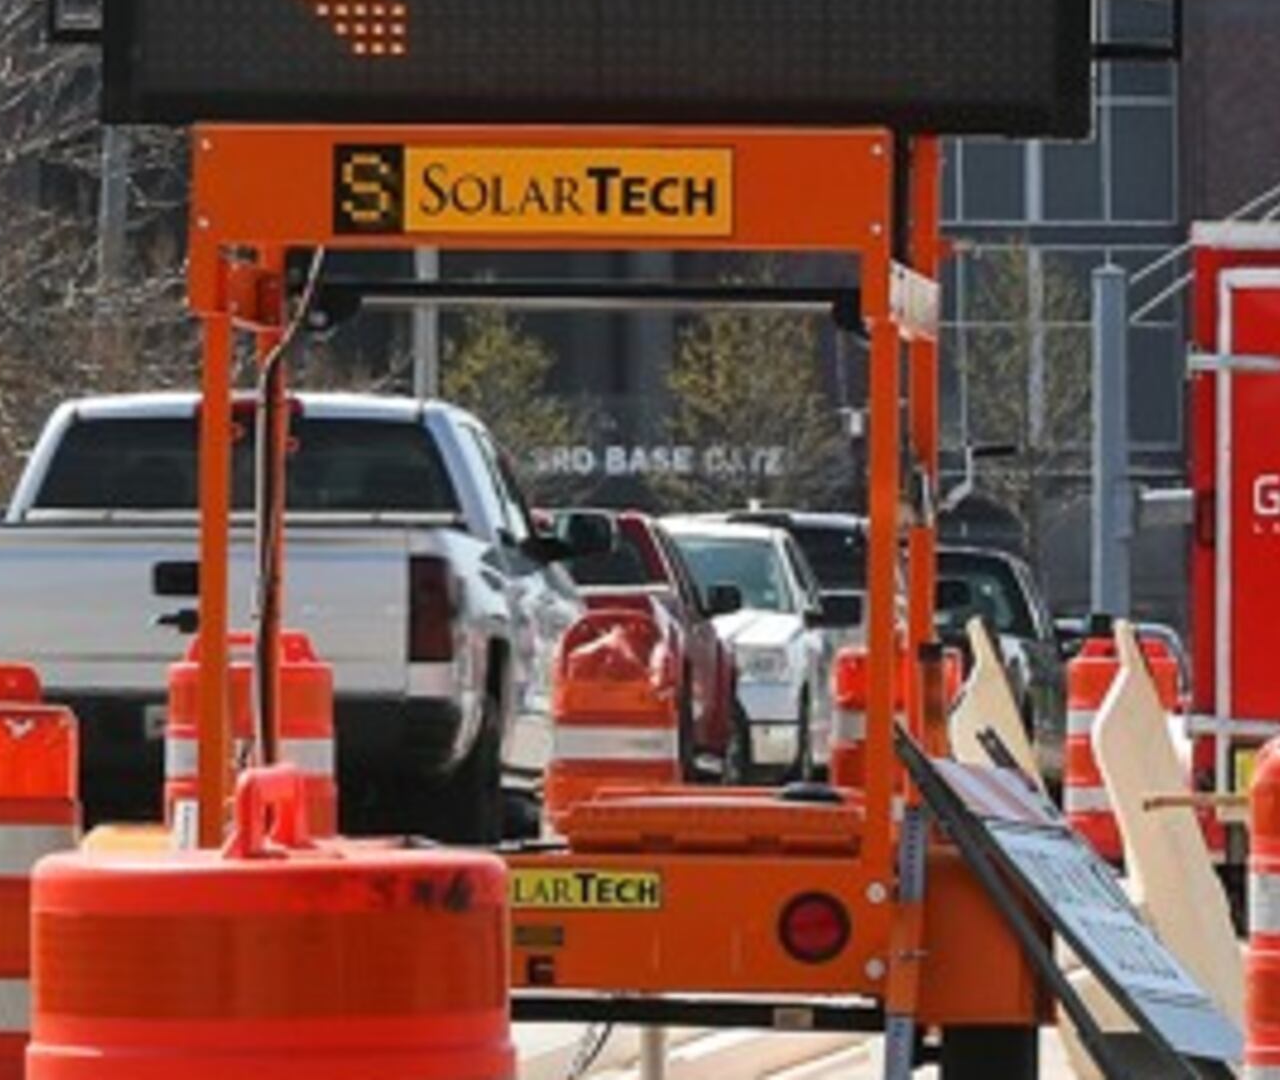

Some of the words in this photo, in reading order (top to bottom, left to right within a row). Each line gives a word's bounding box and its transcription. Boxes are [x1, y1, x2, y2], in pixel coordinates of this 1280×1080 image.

[421, 163, 717, 217] SOLARTECH
[605, 445, 694, 476] BASE
[513, 872, 657, 904] LARTECH
